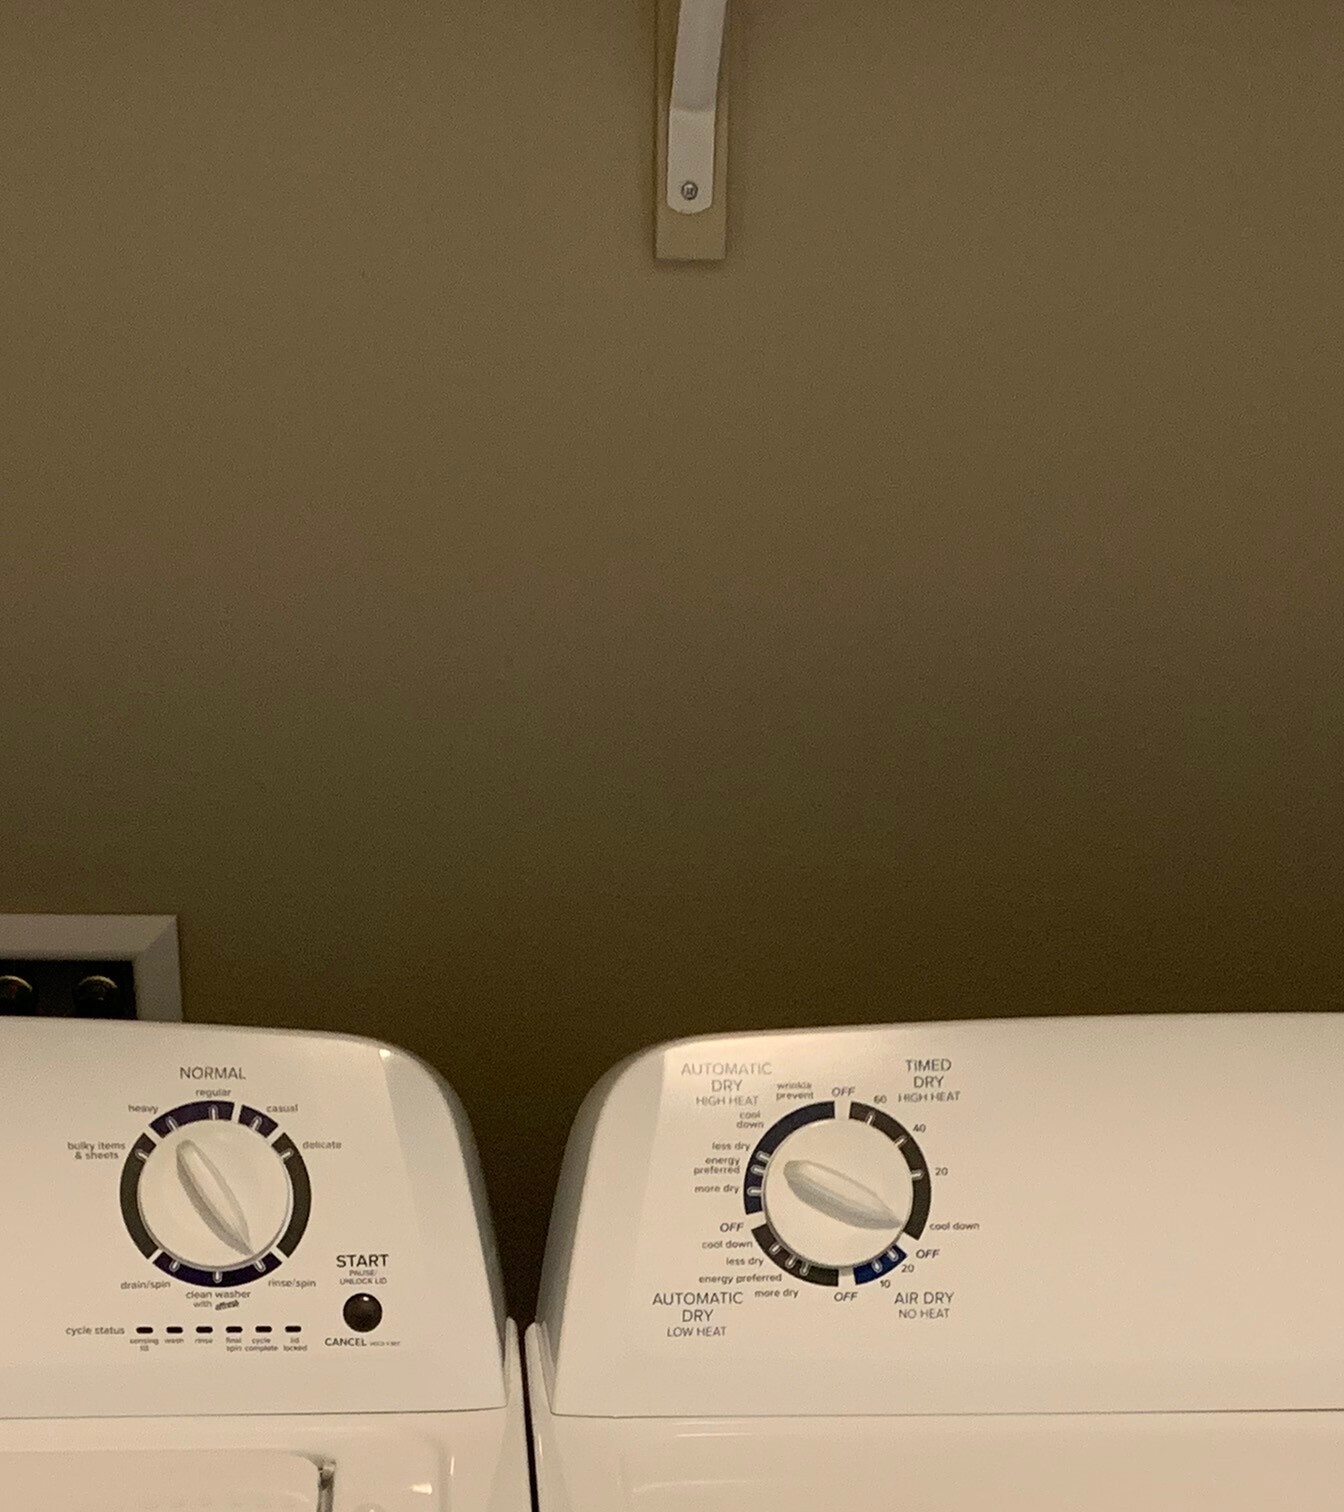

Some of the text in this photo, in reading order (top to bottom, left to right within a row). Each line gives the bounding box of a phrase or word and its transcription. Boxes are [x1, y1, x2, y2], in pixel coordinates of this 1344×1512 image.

[681, 1063, 773, 1076] AUTOMATIC
[905, 1058, 952, 1072] TIMED
[180, 1066, 246, 1080] NORMAL
[711, 1080, 743, 1093] DRY
[777, 1081, 812, 1090] wrinkle
[913, 1075, 945, 1089] DRY
[196, 1089, 231, 1099] regular
[776, 1091, 814, 1101] prevent
[831, 1086, 856, 1097] OFF
[696, 1096, 759, 1107] HIGH HEAT
[897, 1091, 961, 1103] HIGH HEAT
[128, 1104, 159, 1115] heavy
[266, 1104, 298, 1113] casual
[740, 1111, 761, 1119] cool
[736, 1120, 764, 1129] down
[913, 1123, 926, 1133] 40
[67, 1142, 126, 1152] bulky items
[302, 1140, 342, 1150] delicate
[712, 1142, 751, 1151] less dry
[75, 1151, 119, 1160] & sheets
[705, 1157, 740, 1167] energy
[693, 1165, 740, 1176] preferred
[935, 1167, 948, 1176] 20
[723, 1184, 739, 1194] dry
[719, 1223, 744, 1232] OFF
[929, 1222, 980, 1230] cool down
[702, 1239, 753, 1249] cool down
[915, 1249, 941, 1259] OFF
[336, 1254, 389, 1268] START
[726, 1257, 764, 1267] less dry
[901, 1264, 915, 1273] 20
[268, 1279, 317, 1288] rinse/spin
[374, 1277, 388, 1285] LID
[699, 1273, 782, 1285] energy preferred
[880, 1279, 891, 1289] 10
[120, 1281, 171, 1290] drain/spin
[185, 1290, 251, 1299] clean washer
[652, 1292, 744, 1305] AUTOMATIC
[754, 1288, 799, 1299] more dry
[834, 1291, 859, 1302] OFF
[894, 1291, 955, 1305] AIR DRY
[682, 1309, 714, 1322] DRY
[898, 1308, 950, 1319] NO HEAT
[65, 1326, 126, 1336] cycle status
[667, 1326, 727, 1337] LOW HEAT
[324, 1338, 366, 1347] CANCEL
[226, 1345, 242, 1353] spin
[244, 1344, 279, 1353] complete
[283, 1344, 308, 1352] locked
